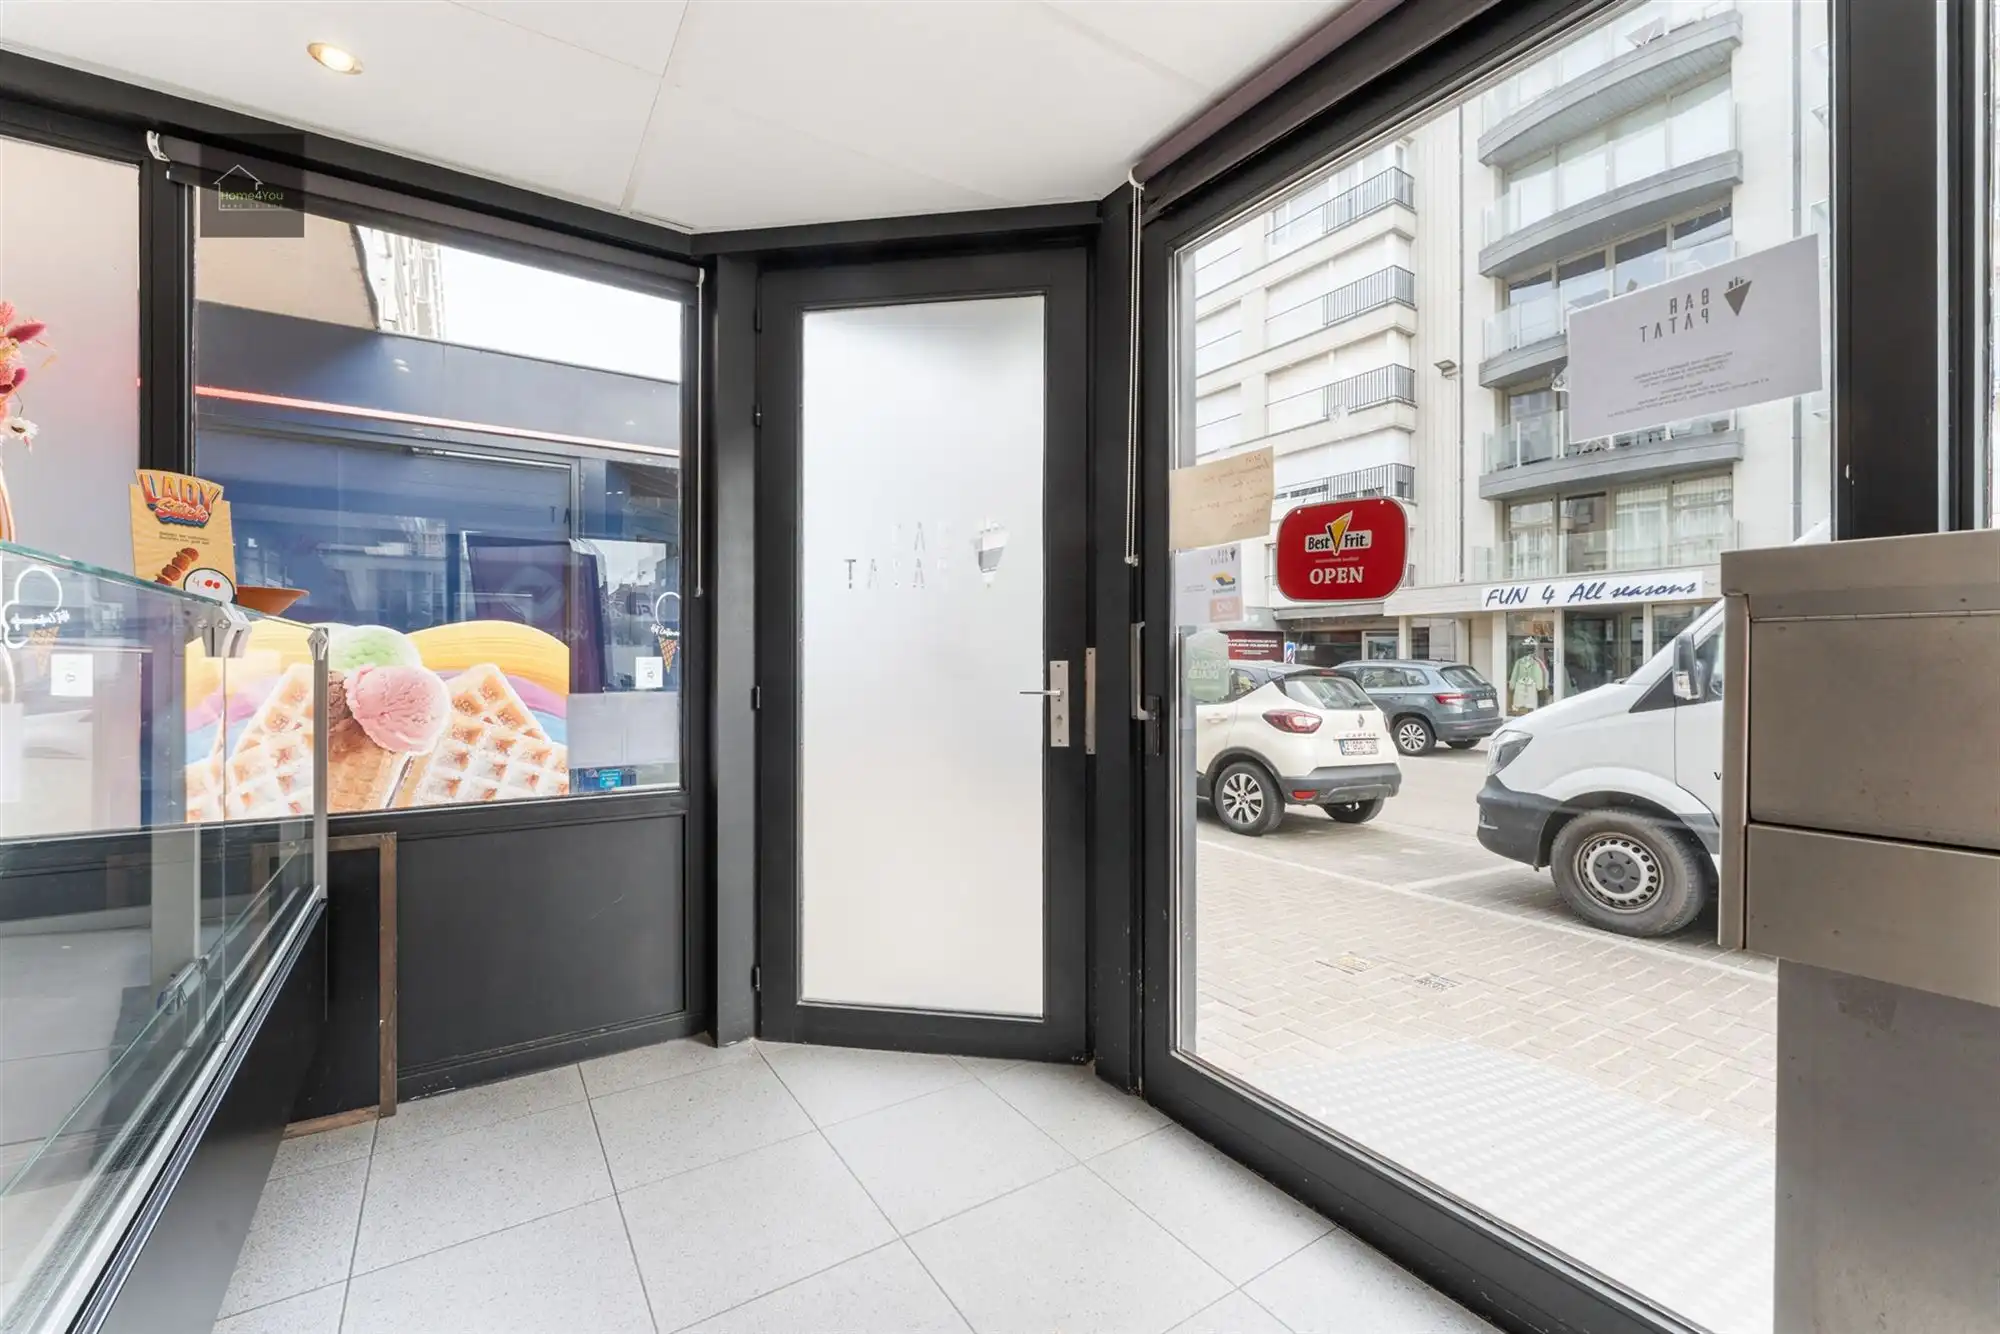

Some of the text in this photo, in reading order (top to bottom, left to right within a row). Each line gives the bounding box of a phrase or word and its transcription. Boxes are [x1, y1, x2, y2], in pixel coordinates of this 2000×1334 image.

[139, 472, 221, 515] LADY
[1308, 533, 1366, 550] Best Frit
[1309, 566, 1364, 585] OPEN
[1485, 580, 1697, 607] FUN 4 All seasons
